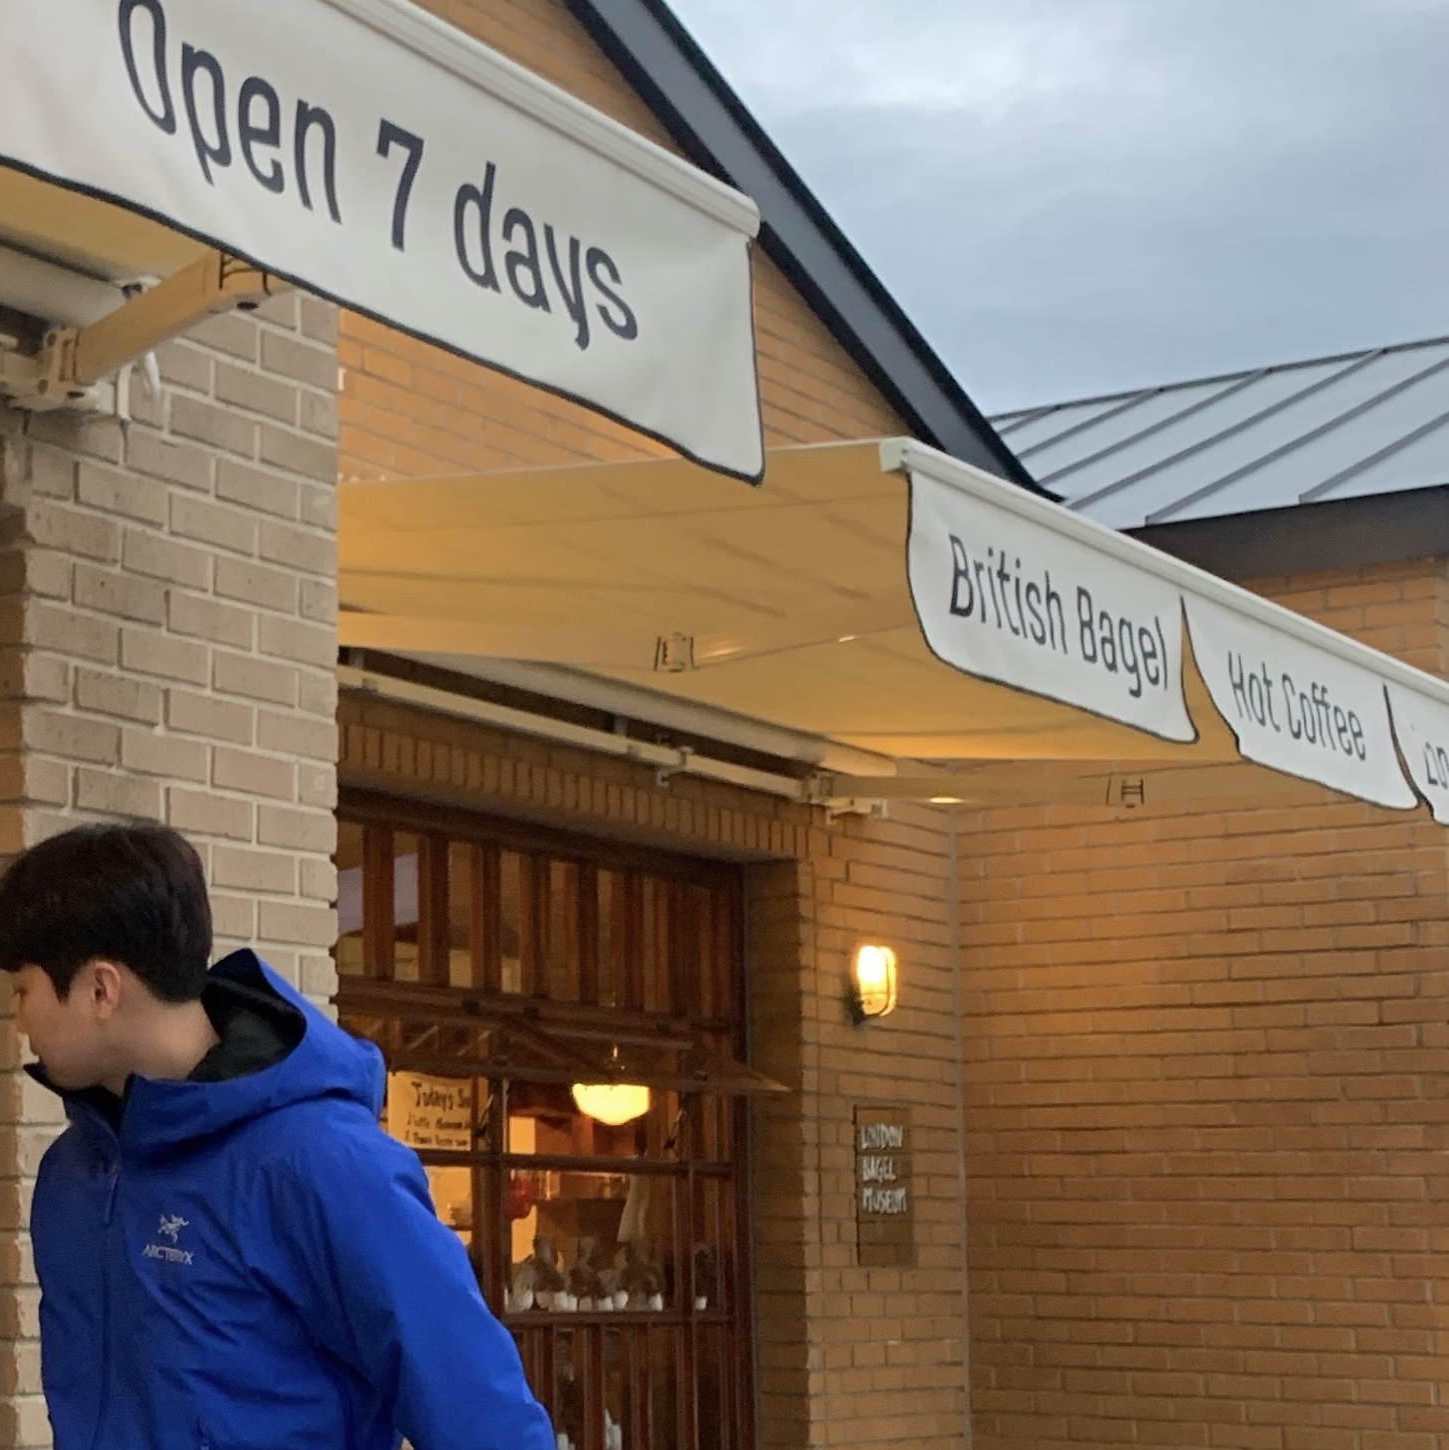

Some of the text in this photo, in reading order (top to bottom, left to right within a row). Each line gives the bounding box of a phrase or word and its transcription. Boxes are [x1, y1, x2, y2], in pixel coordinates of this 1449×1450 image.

[117, 0, 639, 352] Open 7 days
[948, 532, 1168, 699] British Bagel
[1227, 650, 1367, 762] Hot Coffee
[861, 1122, 903, 1149] LONDON
[862, 1155, 897, 1183] BAGEL
[862, 1186, 907, 1214] MUSEUM
